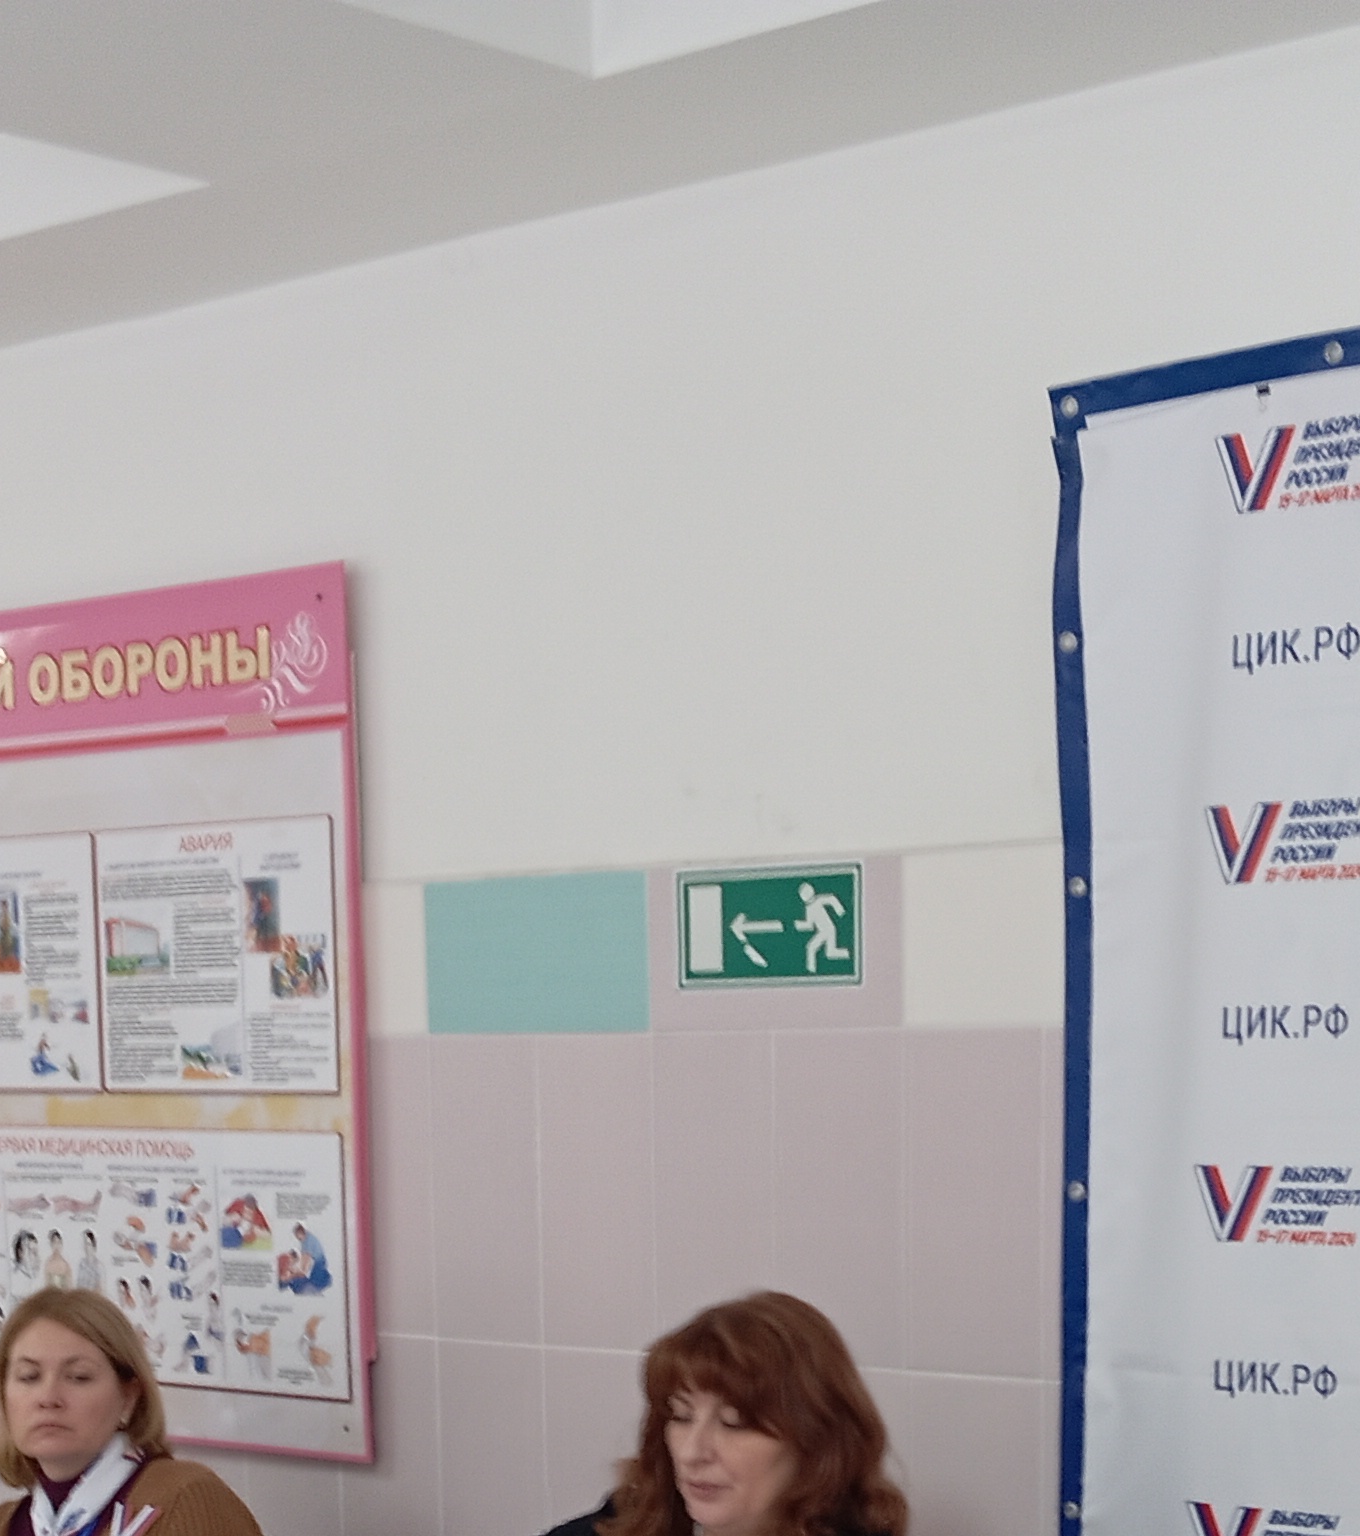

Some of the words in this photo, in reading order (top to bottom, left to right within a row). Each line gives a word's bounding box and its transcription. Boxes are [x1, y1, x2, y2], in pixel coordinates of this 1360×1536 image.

[27, 624, 272, 708] ОБОРОНЫ
[179, 831, 234, 852] АВАРИЯ
[1221, 1002, 1350, 1047] ЦИК.РФ
[1213, 1358, 1339, 1399] ЦИК.РФ
